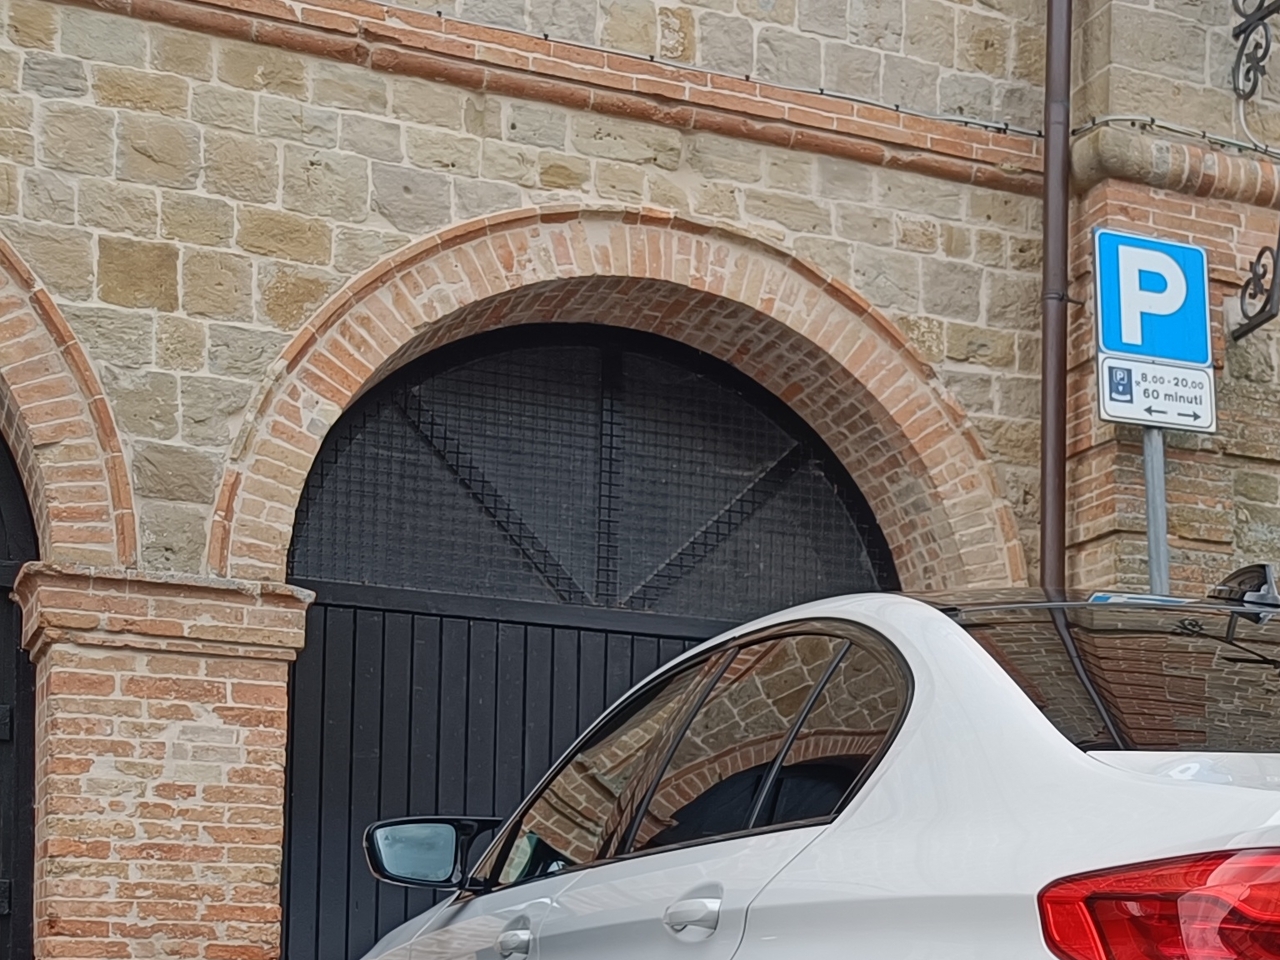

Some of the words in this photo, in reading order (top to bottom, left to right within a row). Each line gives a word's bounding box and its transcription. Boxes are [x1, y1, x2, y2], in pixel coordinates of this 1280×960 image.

[1118, 244, 1187, 346] P
[1143, 388, 1160, 400] 60
[1164, 392, 1203, 405] minuti
